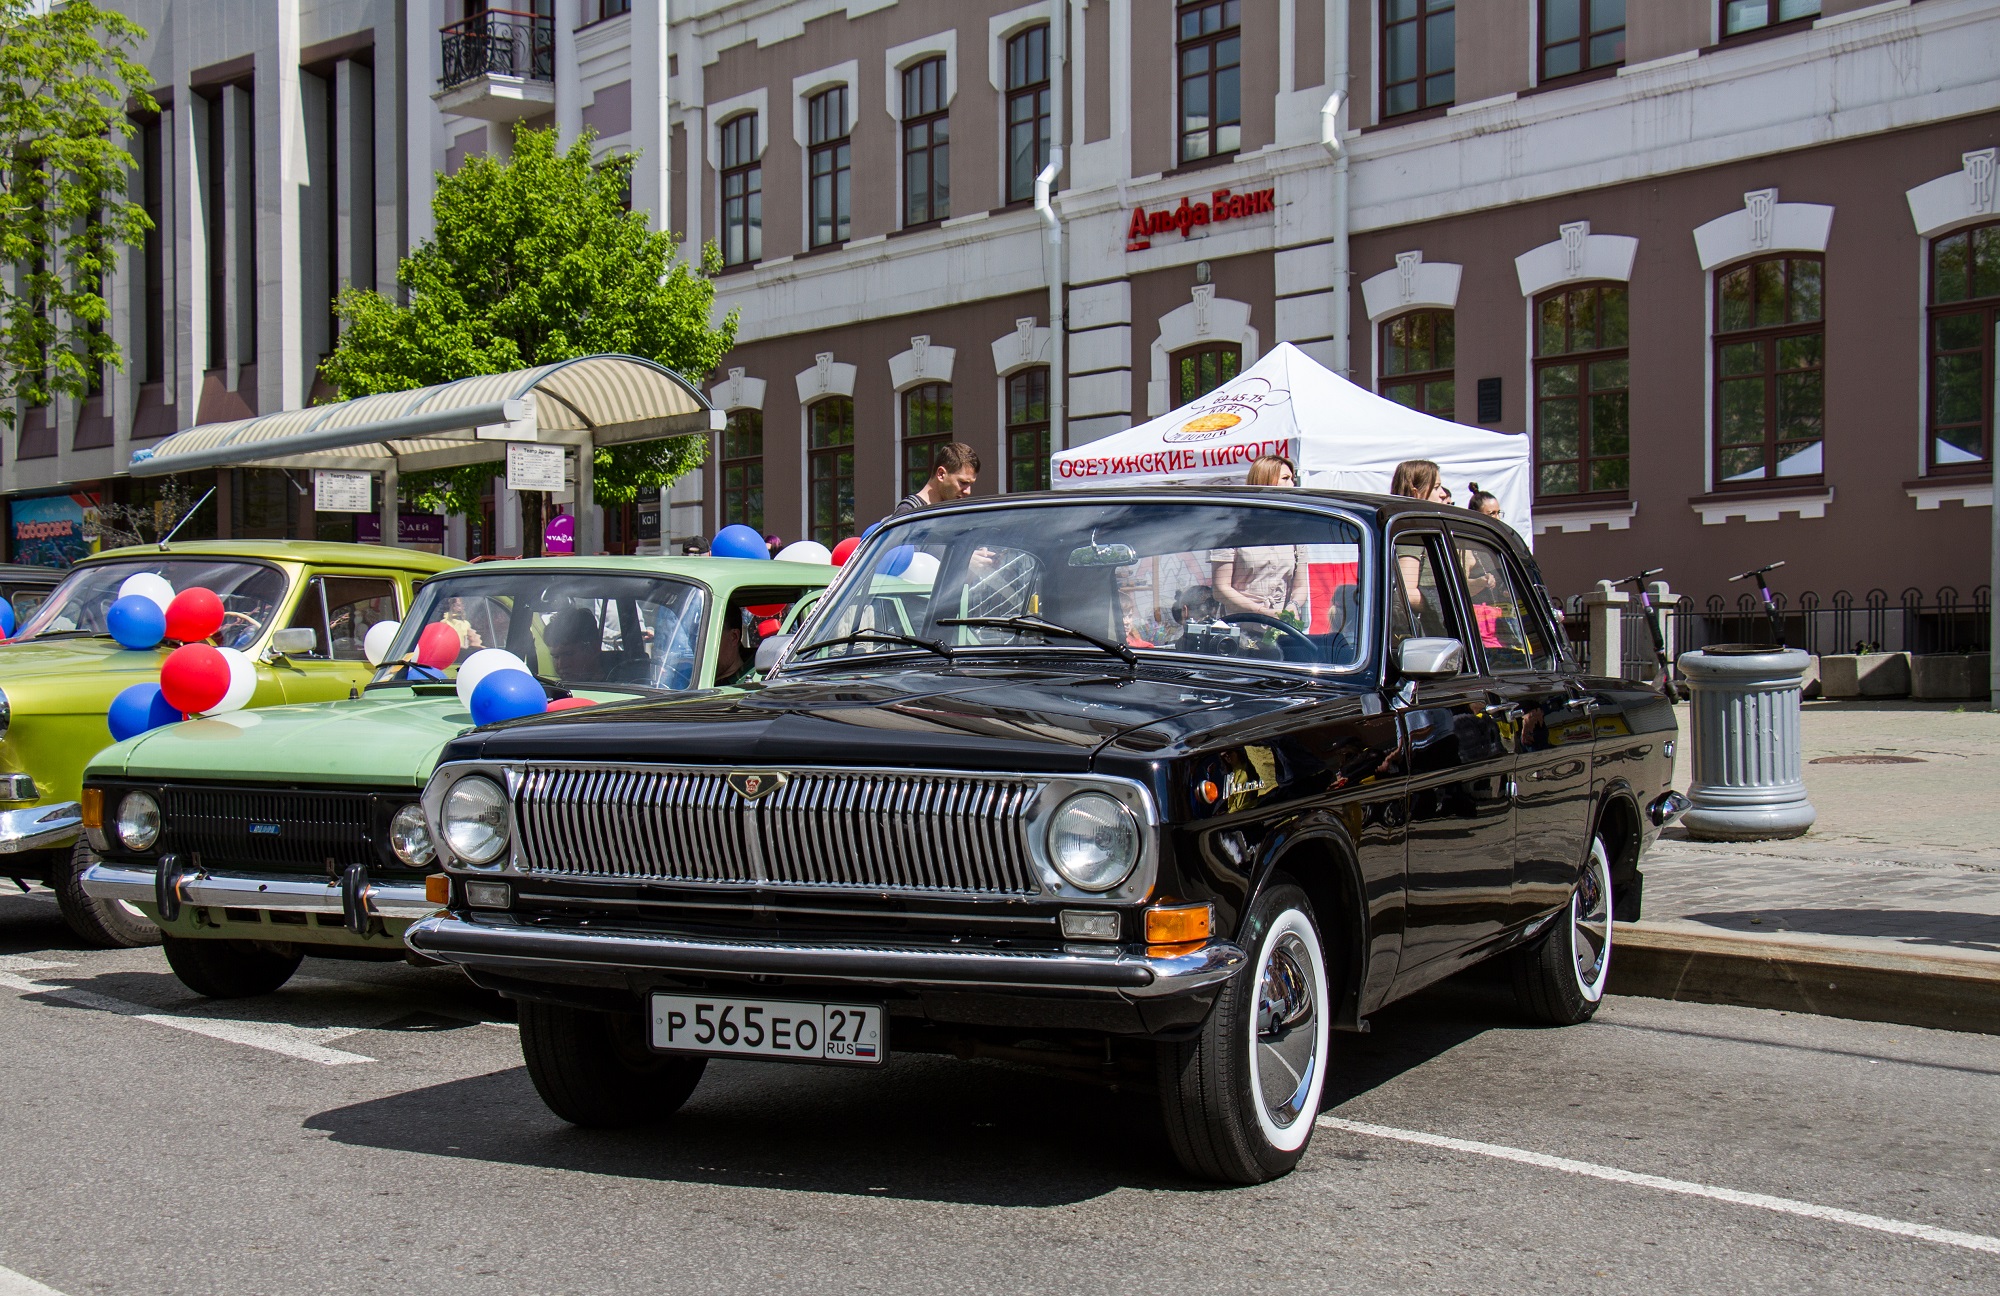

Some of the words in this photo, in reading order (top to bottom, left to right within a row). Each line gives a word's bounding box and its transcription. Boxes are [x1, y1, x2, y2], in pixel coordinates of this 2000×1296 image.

[1127, 196, 1210, 241] Альфа
[1212, 188, 1275, 222] Банк
[1213, 393, 1265, 405] 69-45-75
[1059, 449, 1196, 479] ОСЕТИНСКИЕ
[1202, 438, 1290, 468] ПИРОГИ
[16, 519, 73, 541] Хабаровск
[829, 1009, 867, 1043] 27
[827, 1042, 855, 1055] RUS
